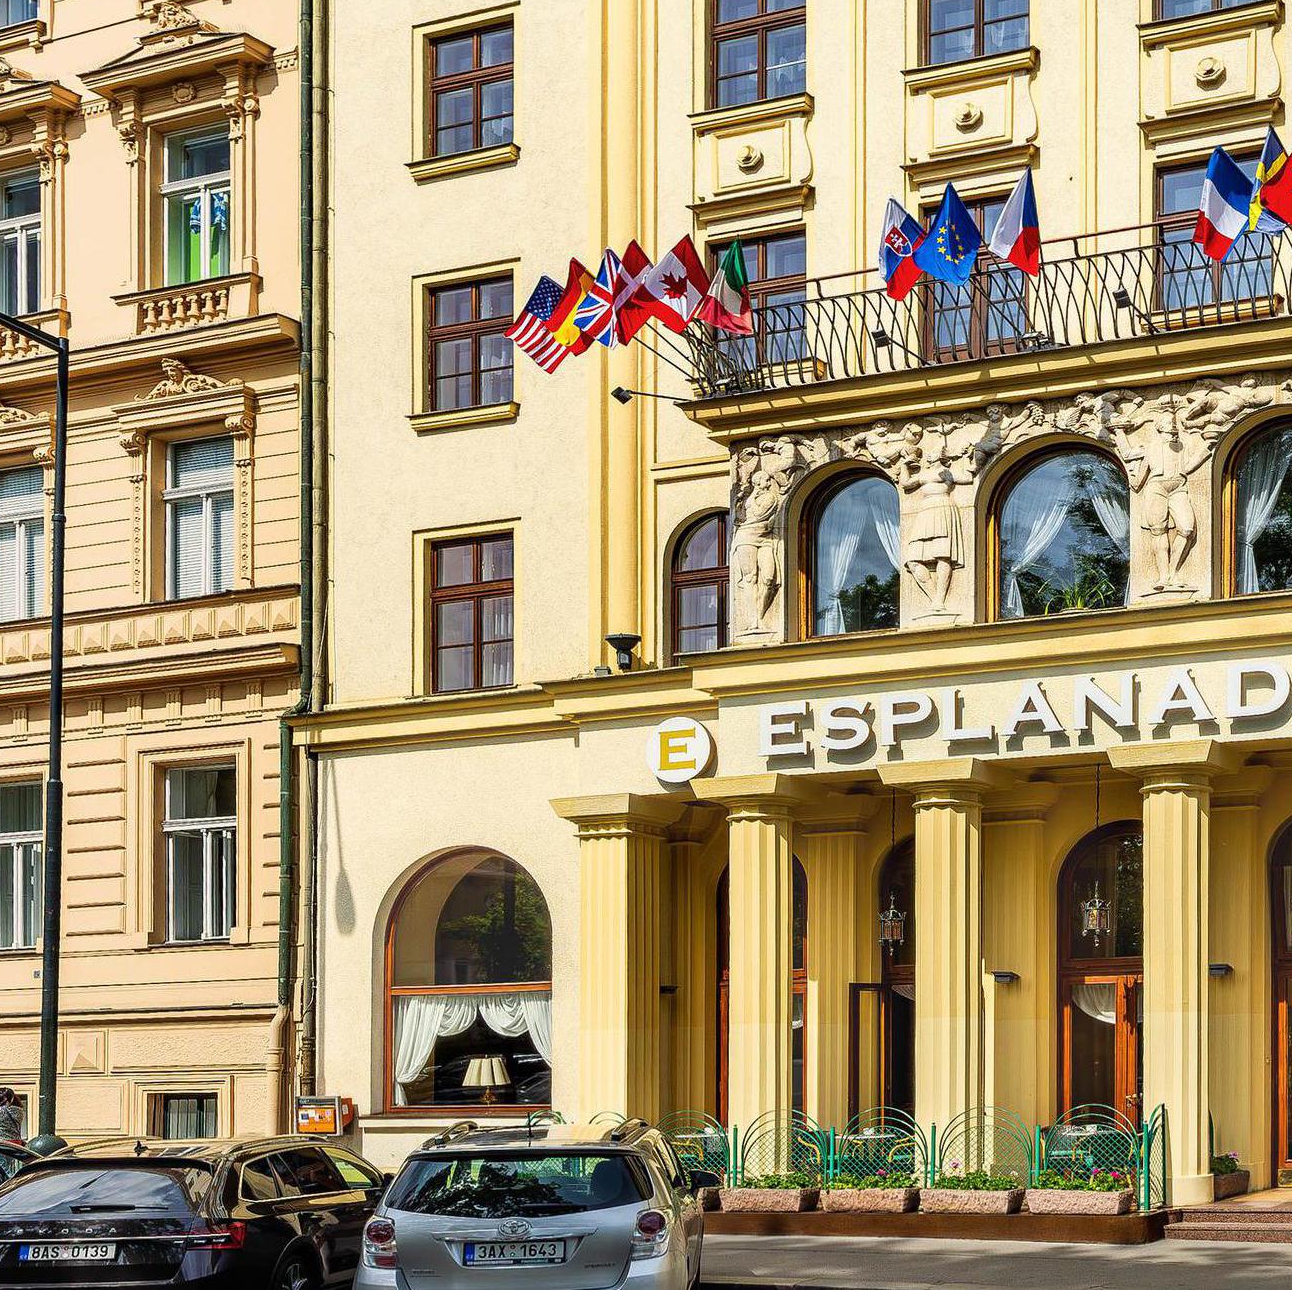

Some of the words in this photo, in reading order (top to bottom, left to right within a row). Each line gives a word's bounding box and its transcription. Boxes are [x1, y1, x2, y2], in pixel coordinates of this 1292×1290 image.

[656, 728, 697, 771] E
[32, 1246, 60, 1259] 8AS
[71, 1245, 109, 1258] 0139
[478, 1245, 505, 1258] 3AX
[520, 1243, 557, 1257] 1643
